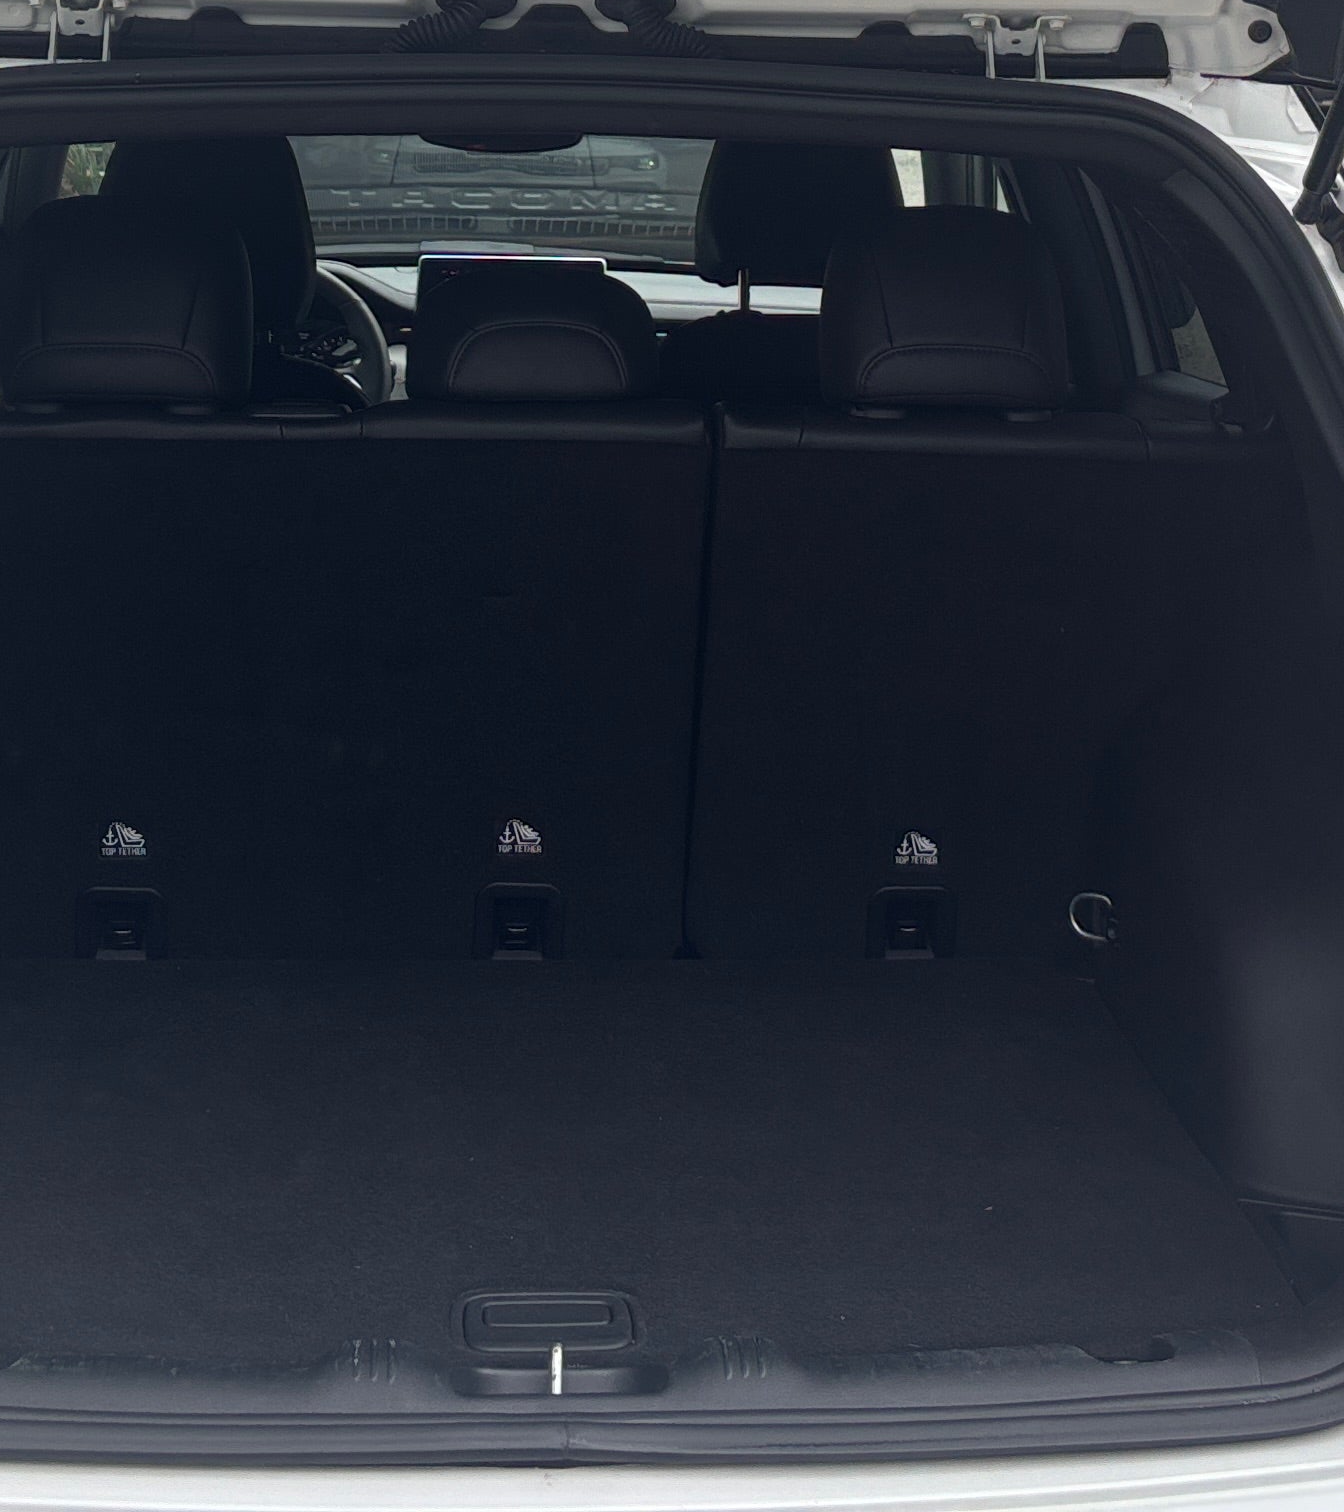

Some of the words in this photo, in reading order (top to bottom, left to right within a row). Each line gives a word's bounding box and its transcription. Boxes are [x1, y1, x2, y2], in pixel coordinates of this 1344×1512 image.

[329, 187, 676, 211] TACOMA
[101, 847, 116, 856] TOP
[118, 847, 146, 856] TETHER
[498, 844, 513, 853] TOP
[514, 845, 542, 853] TETHER
[895, 855, 909, 864] TOP
[911, 855, 938, 865] TETHER
